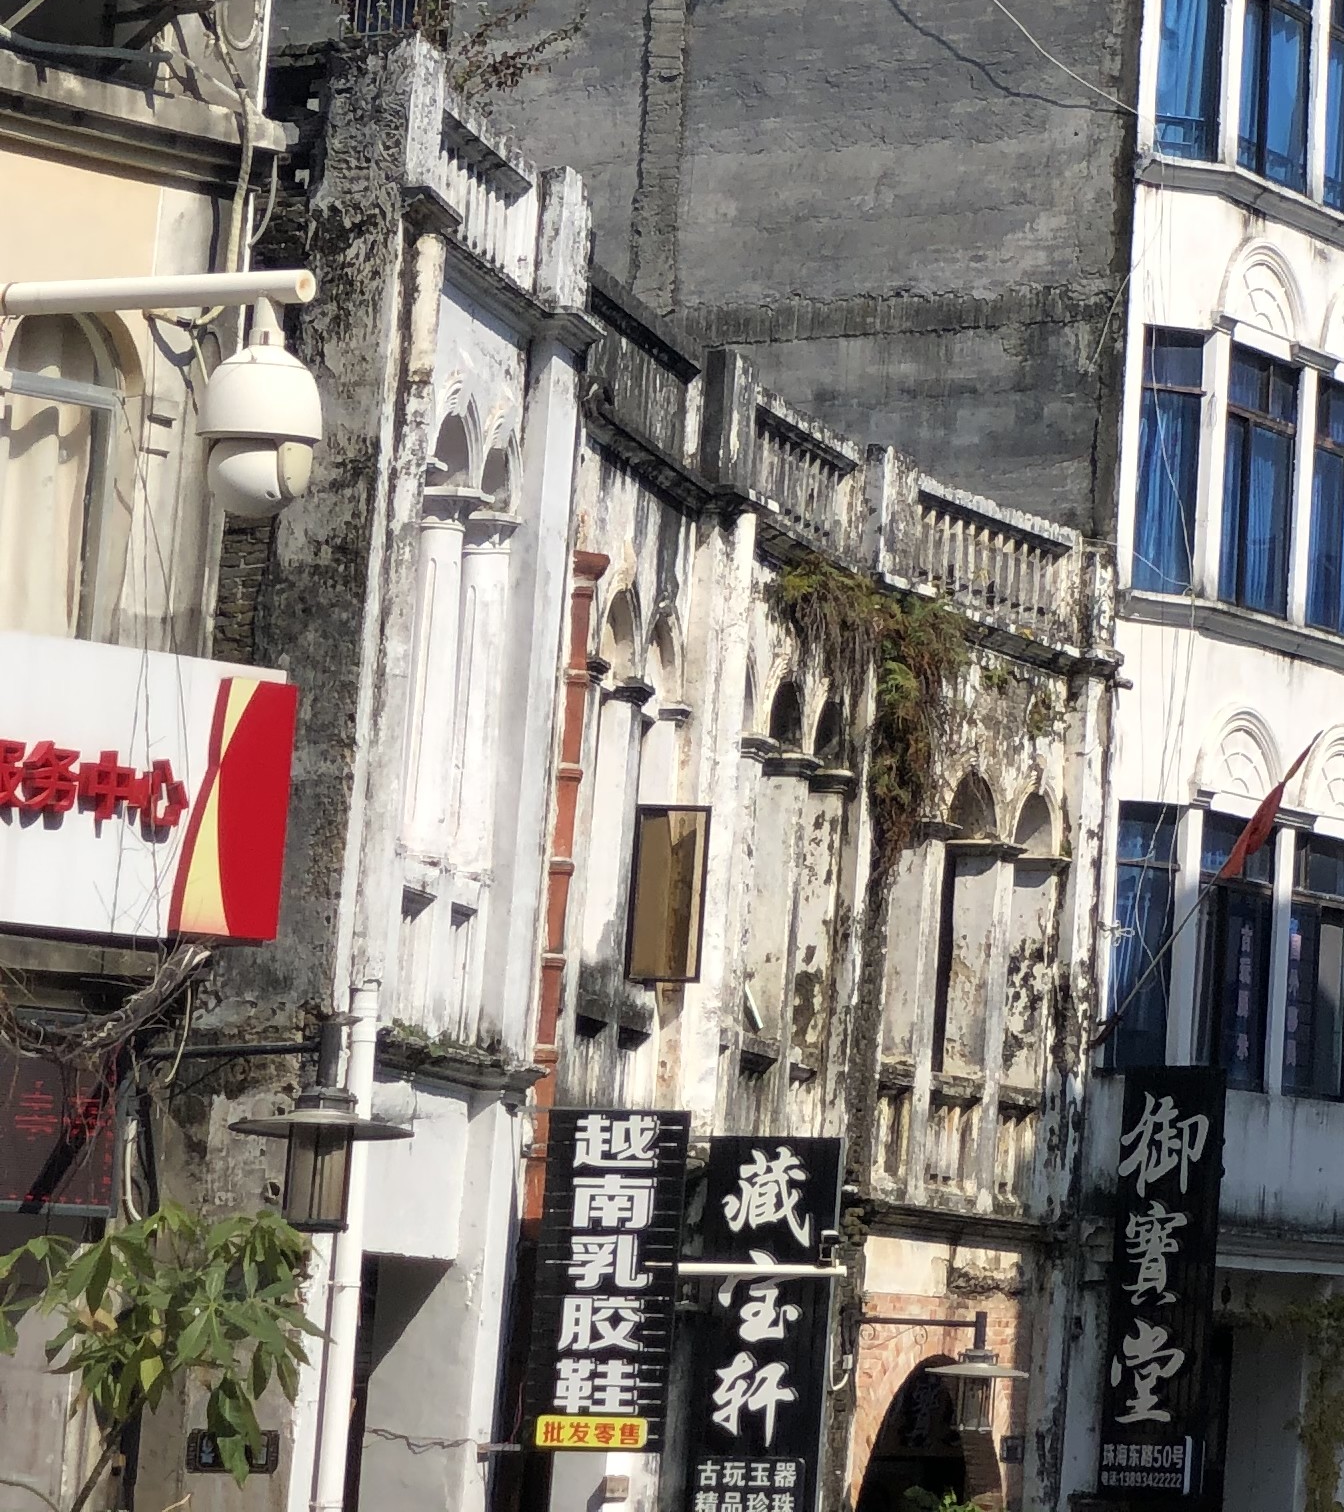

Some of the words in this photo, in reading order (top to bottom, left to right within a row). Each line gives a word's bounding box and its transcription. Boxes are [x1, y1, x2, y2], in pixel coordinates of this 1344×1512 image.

[553, 1114, 661, 1415] 越南乳胶鞋
[1110, 1091, 1209, 1424] 御寶堂
[711, 1146, 811, 1447] 藏宝轩
[542, 1419, 642, 1445] 批发零售
[1102, 1443, 1184, 1469] 珠海东路50号
[697, 1459, 797, 1487] 古玩玉器
[694, 1490, 795, 1512] 精品珍珠
